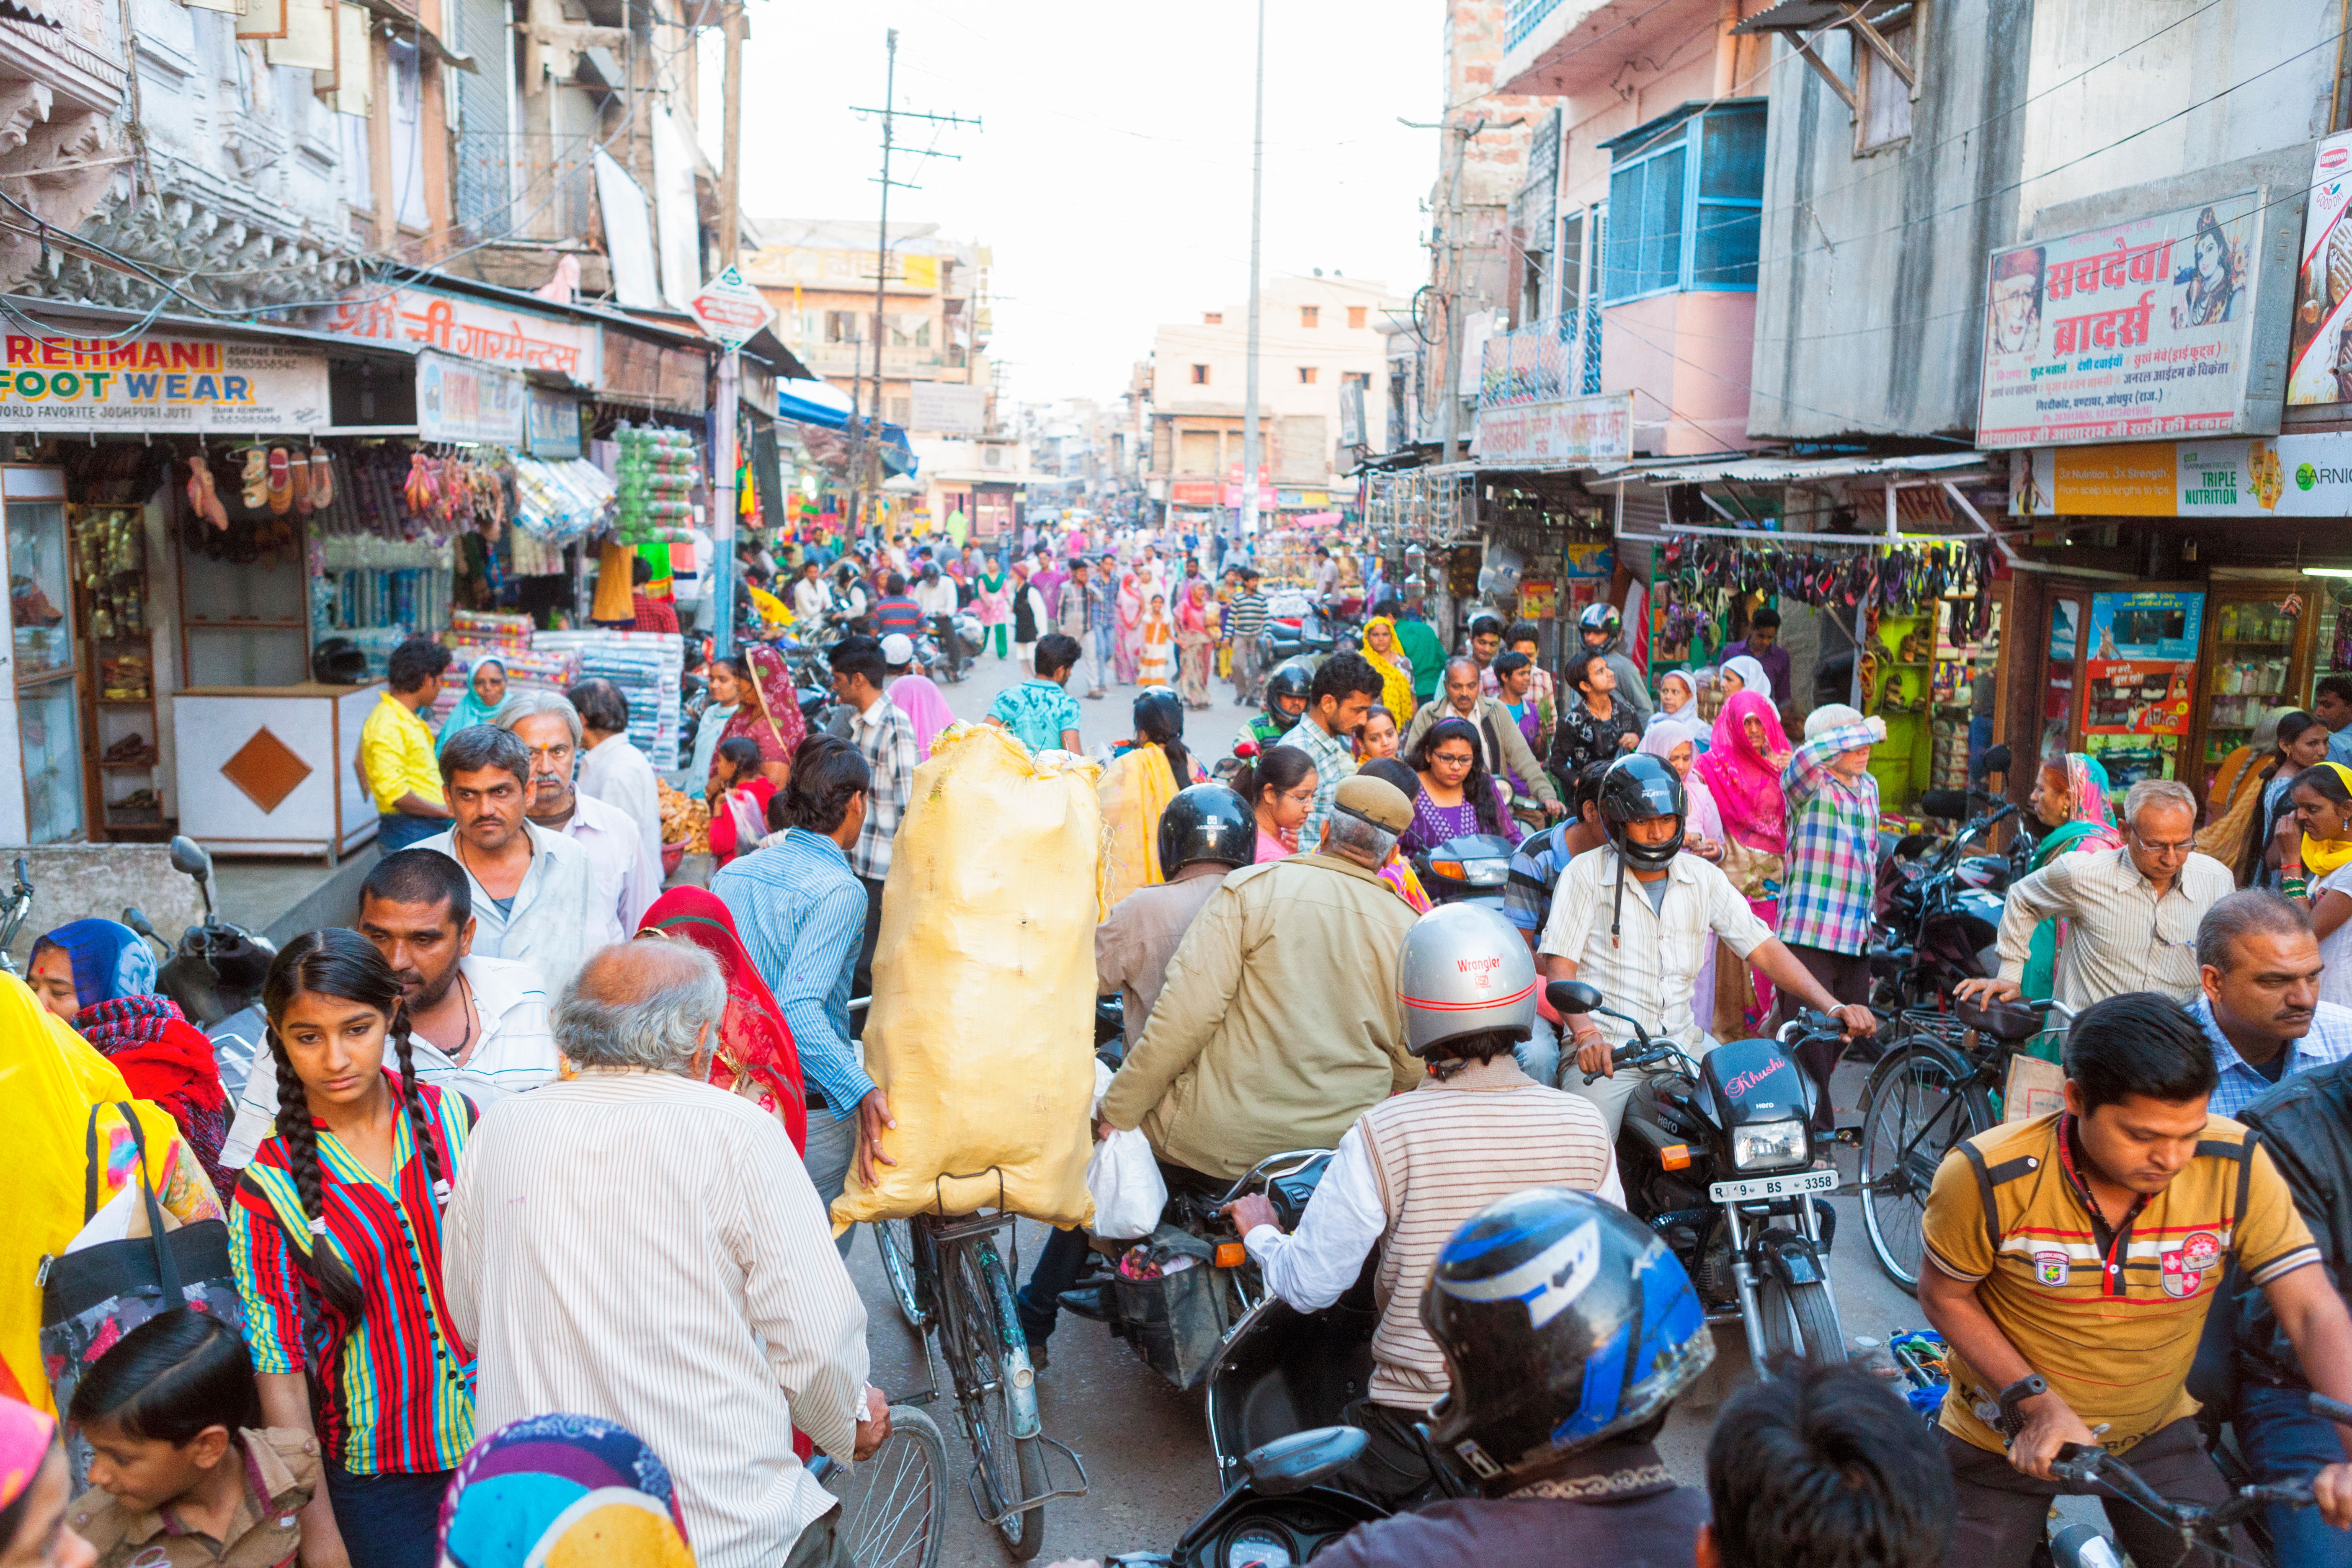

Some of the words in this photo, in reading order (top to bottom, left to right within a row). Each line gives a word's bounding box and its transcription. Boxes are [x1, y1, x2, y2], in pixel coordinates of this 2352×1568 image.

[2321, 151, 2347, 164] BRITANNIA
[2316, 193, 2332, 210] GOOD
[2333, 189, 2344, 207] DAY
[2046, 236, 2176, 302] सचदेवा
[2053, 289, 2155, 359] ब्रादर्स
[6, 335, 223, 373] REHMANI
[124, 373, 257, 405] WEAR
[0, 405, 34, 418] ORLD
[38, 406, 95, 418] FAVORITE
[2201, 471, 2237, 488] TRIPLE
[2185, 489, 2237, 505] NUTRITION
[1457, 955, 1500, 972] Wrangler
[1725, 1057, 1785, 1098] Khushi
[1767, 1181, 1782, 1193] BS
[1805, 1176, 1832, 1189] 3358
[2036, 1252, 2068, 1261] AIRBORNE
